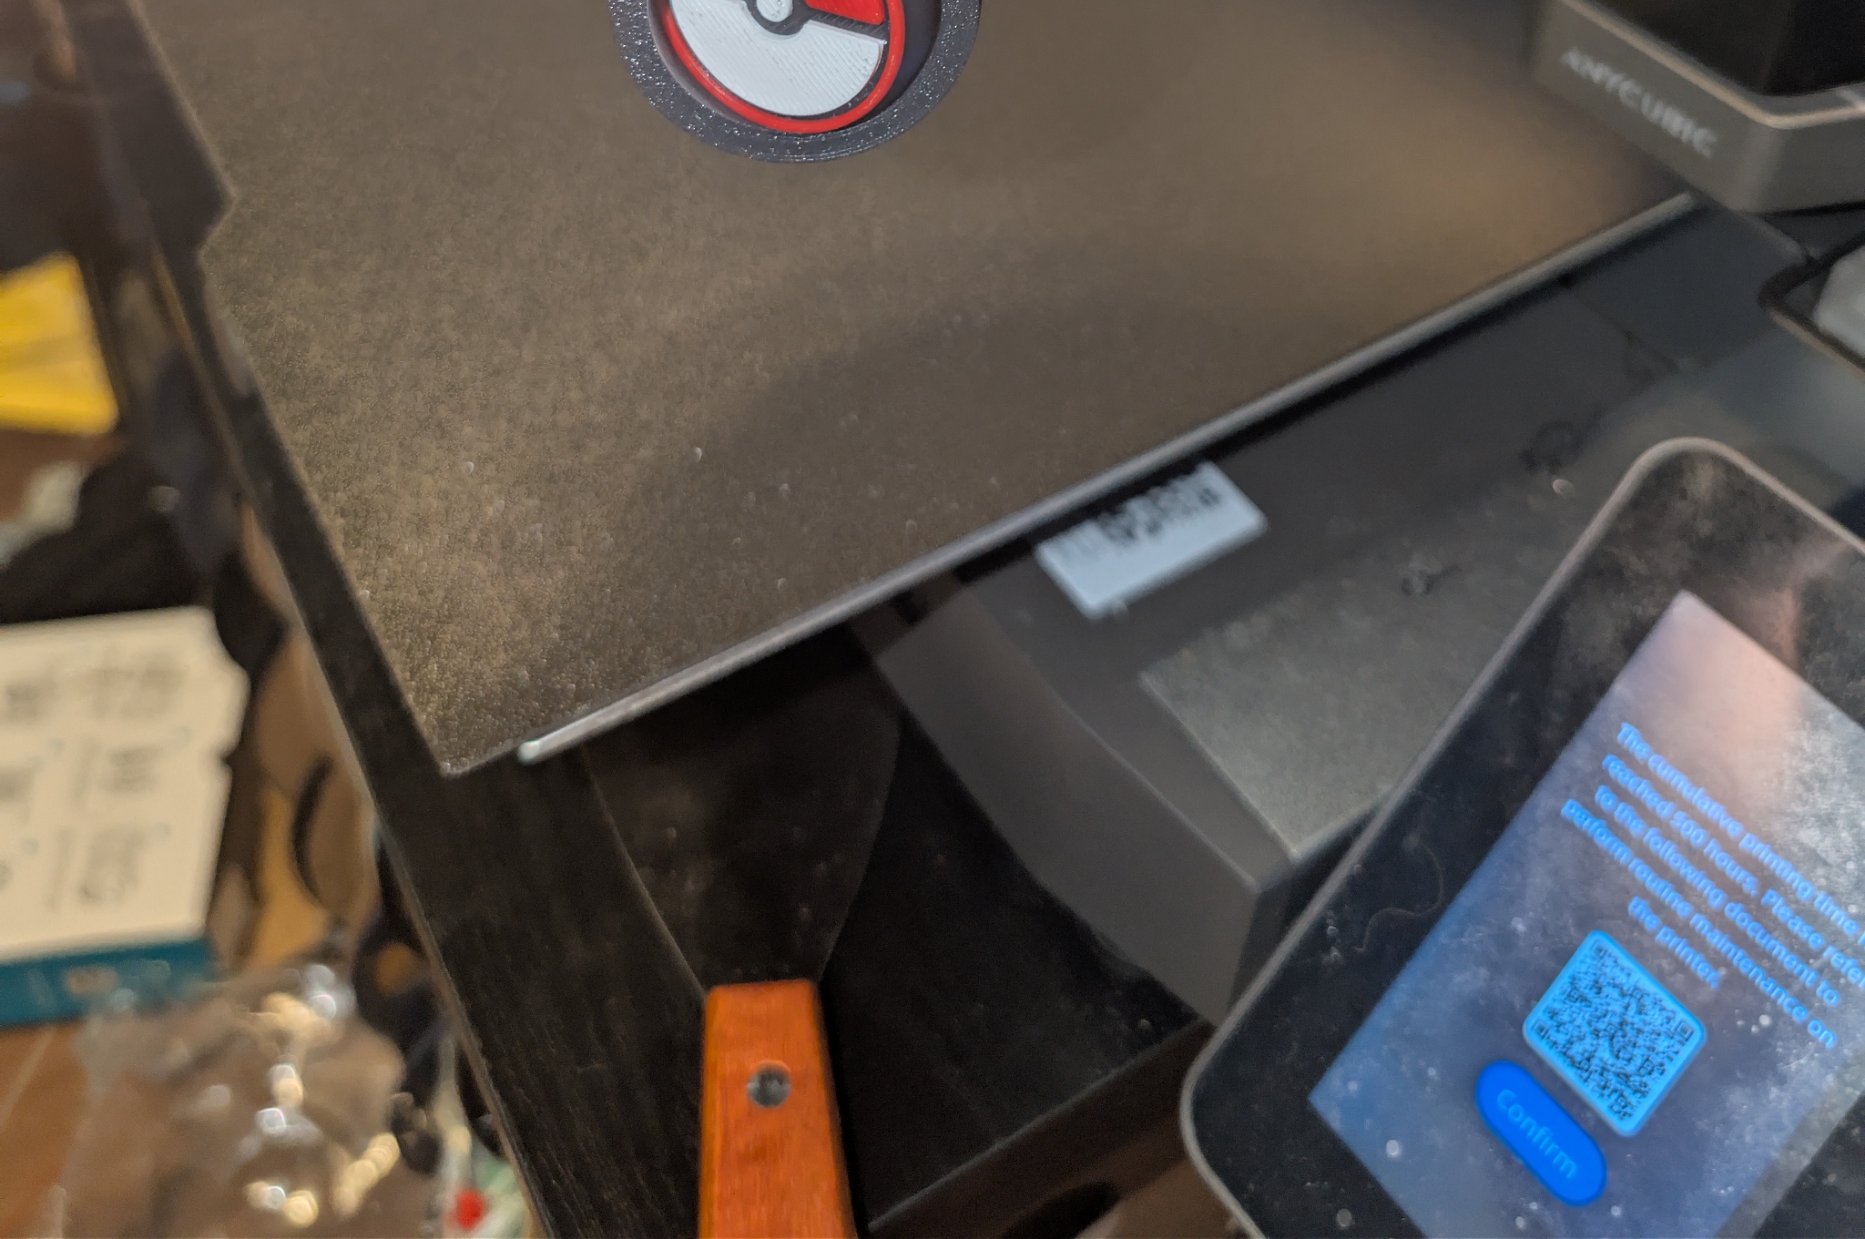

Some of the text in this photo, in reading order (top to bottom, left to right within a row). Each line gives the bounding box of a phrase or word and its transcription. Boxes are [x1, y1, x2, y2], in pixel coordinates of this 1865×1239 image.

[1560, 47, 1718, 159] ANYCUBIC
[1561, 799, 1837, 1049] perform routine maintenance on
[1595, 784, 1619, 814] to
[1614, 802, 1647, 839] the
[1643, 828, 1728, 909] following
[1724, 901, 1819, 987] document
[1816, 979, 1840, 1007] to
[1602, 754, 1675, 820] reached
[1669, 811, 1708, 849] 500
[1703, 838, 1758, 896] hours.
[1761, 889, 1825, 950] Please
[1617, 722, 1858, 937] The cumulative printing time
[1628, 896, 1720, 989] the printer.
[1496, 1089, 1577, 1180] Confirm
